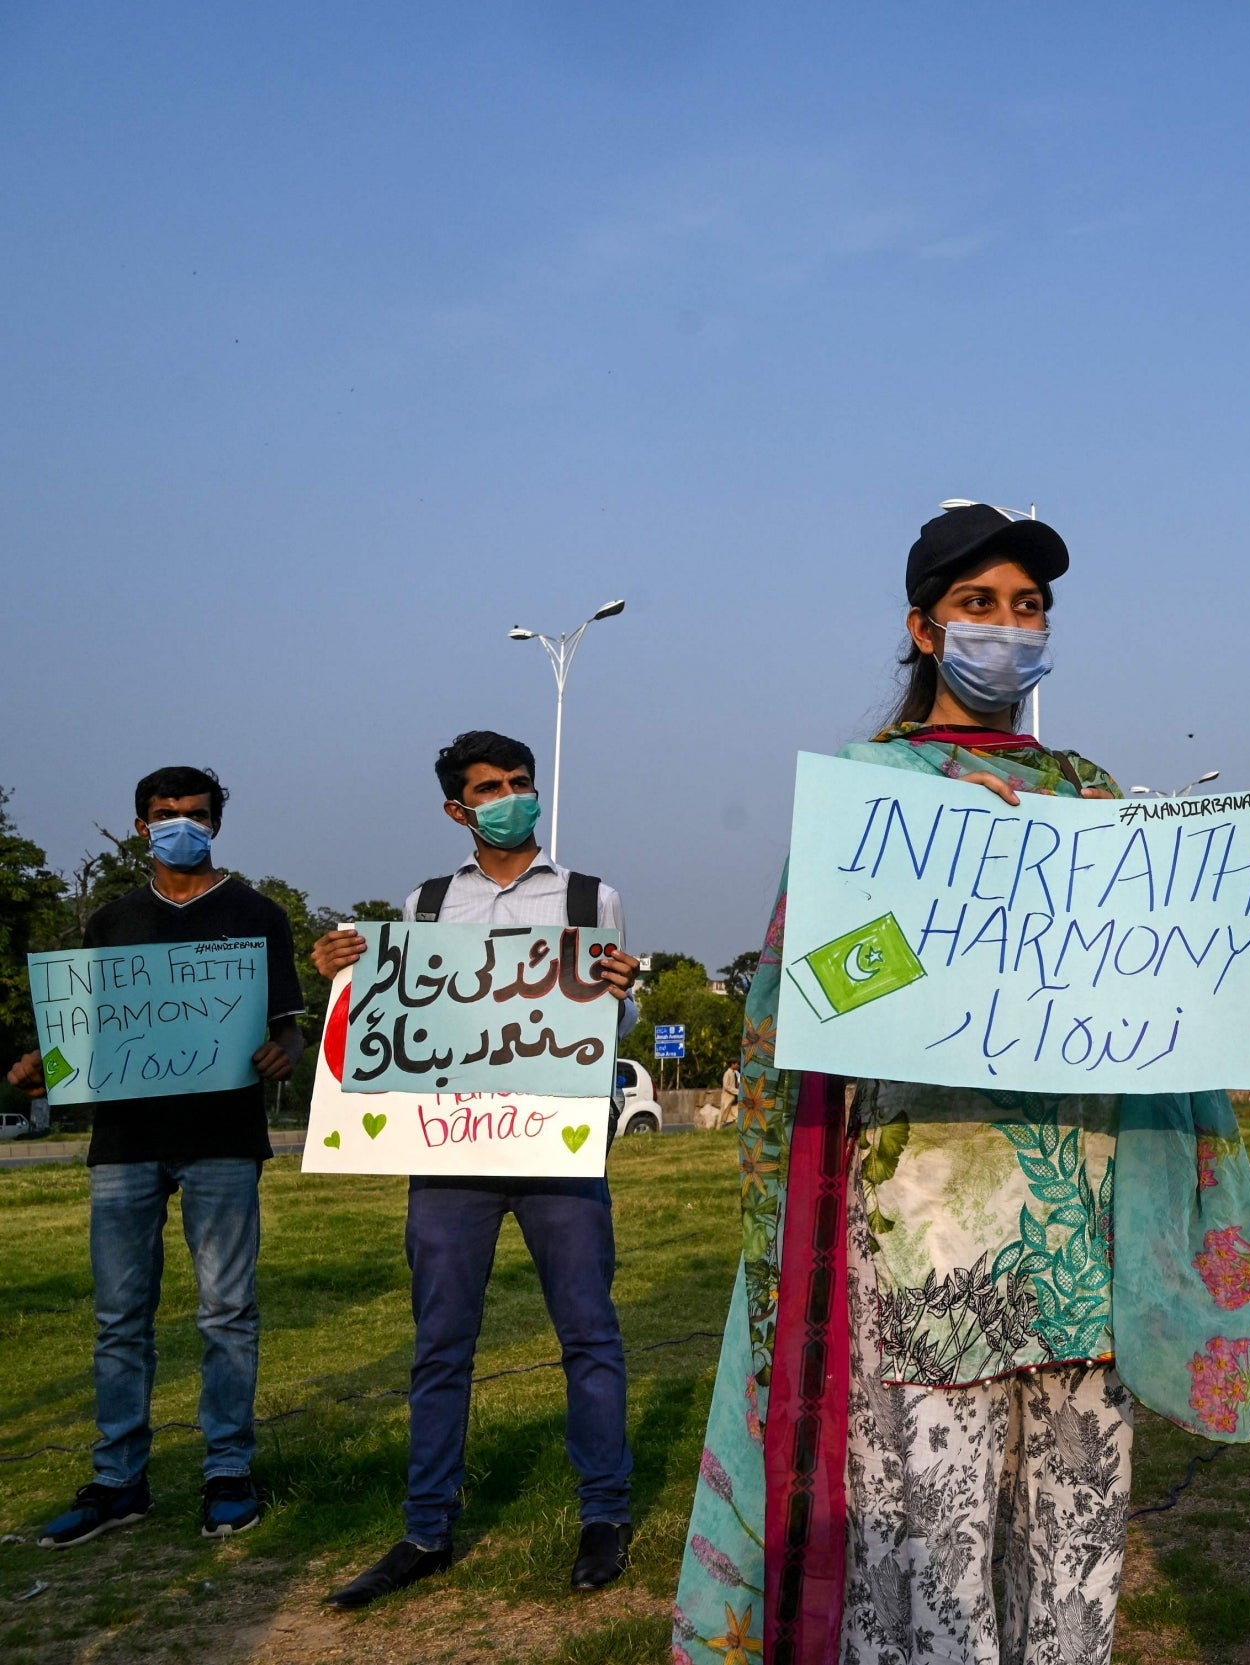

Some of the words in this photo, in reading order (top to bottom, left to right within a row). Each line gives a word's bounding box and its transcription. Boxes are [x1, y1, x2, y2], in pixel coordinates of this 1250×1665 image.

[32, 955, 151, 1004] INTER
[167, 945, 257, 984] FAITH
[349, 922, 449, 1026] خاطر
[45, 995, 242, 1044] HARMONY
[459, 1009, 604, 1066] مندر
[418, 1104, 559, 1148] banao
